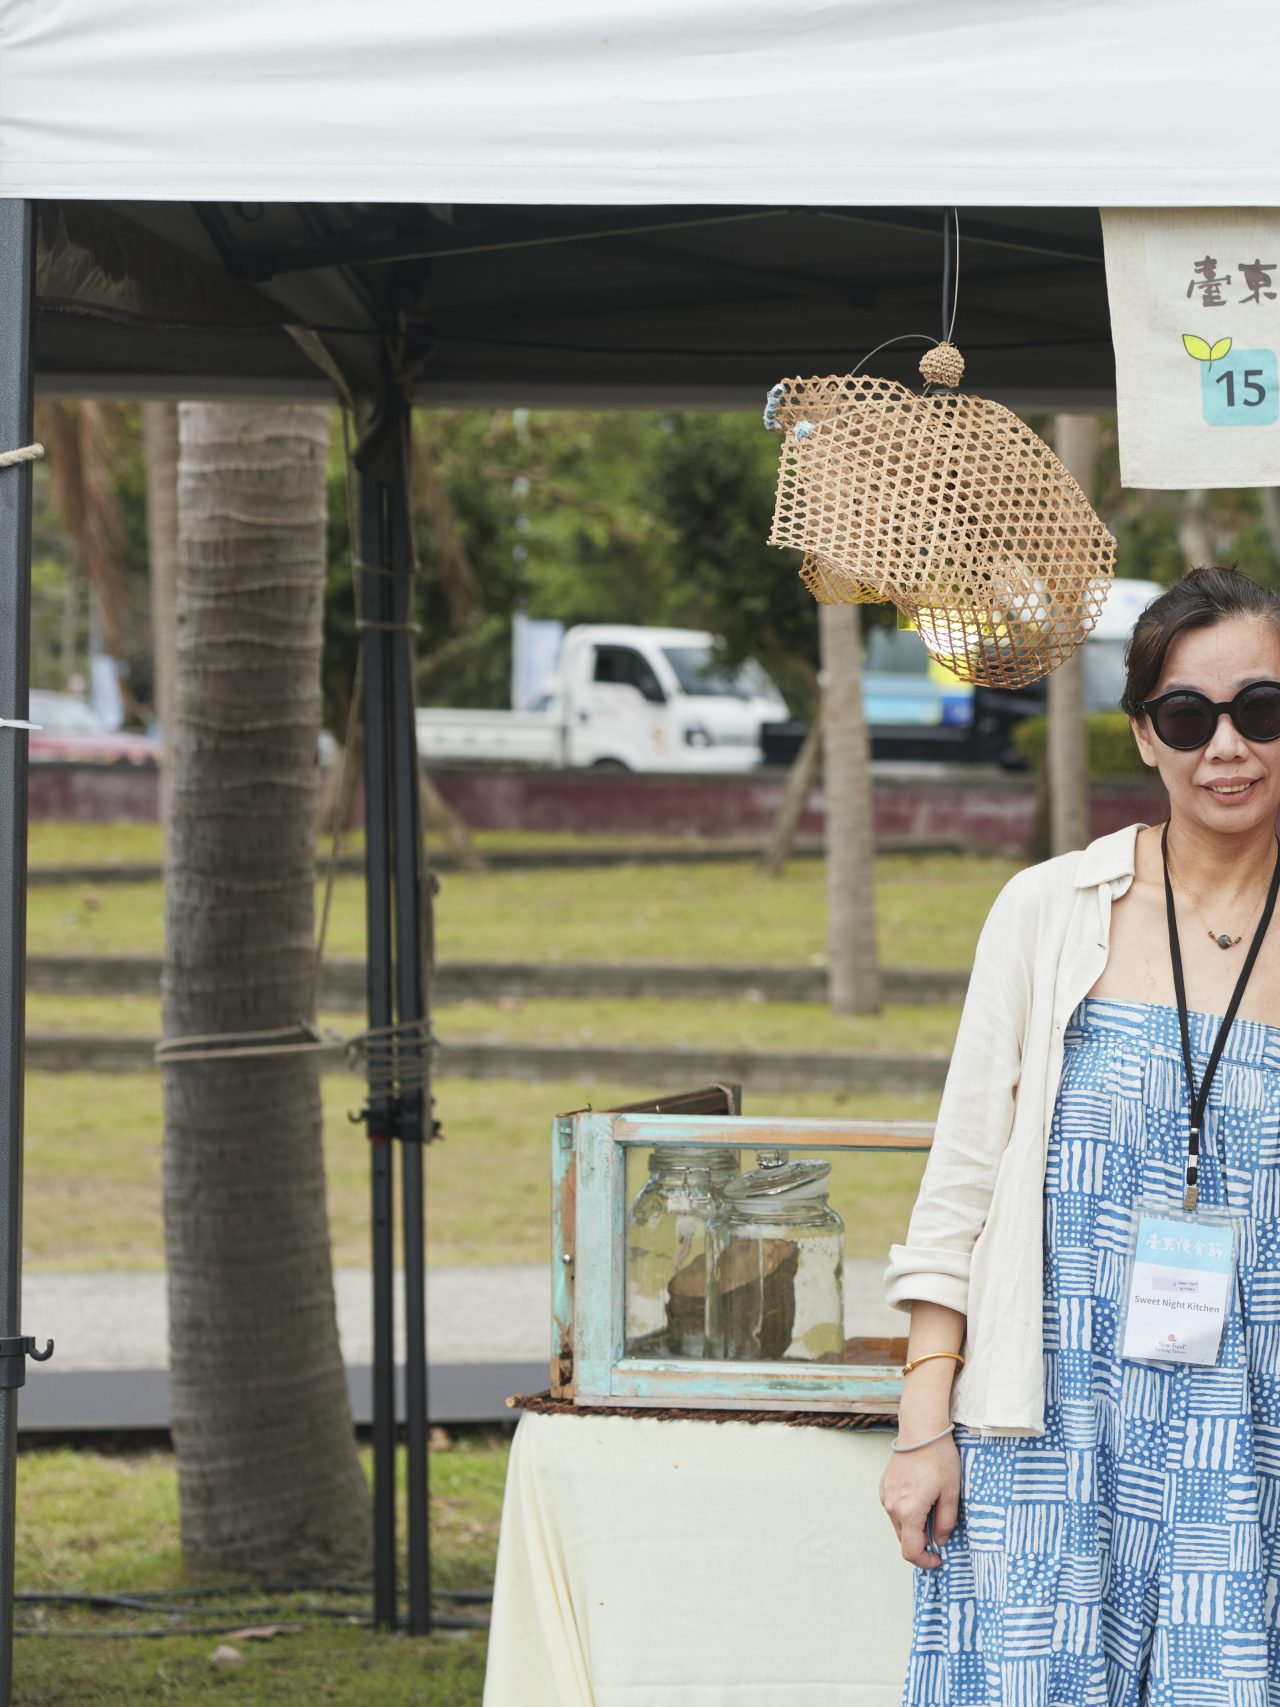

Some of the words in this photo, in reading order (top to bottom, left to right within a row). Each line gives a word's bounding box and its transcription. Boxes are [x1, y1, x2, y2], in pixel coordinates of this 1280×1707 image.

[1215, 369, 1267, 407] 15
[1134, 1295, 1161, 1306] Sweet
[1162, 1298, 1186, 1310] Night
[1187, 1302, 1220, 1313] Kitchen
